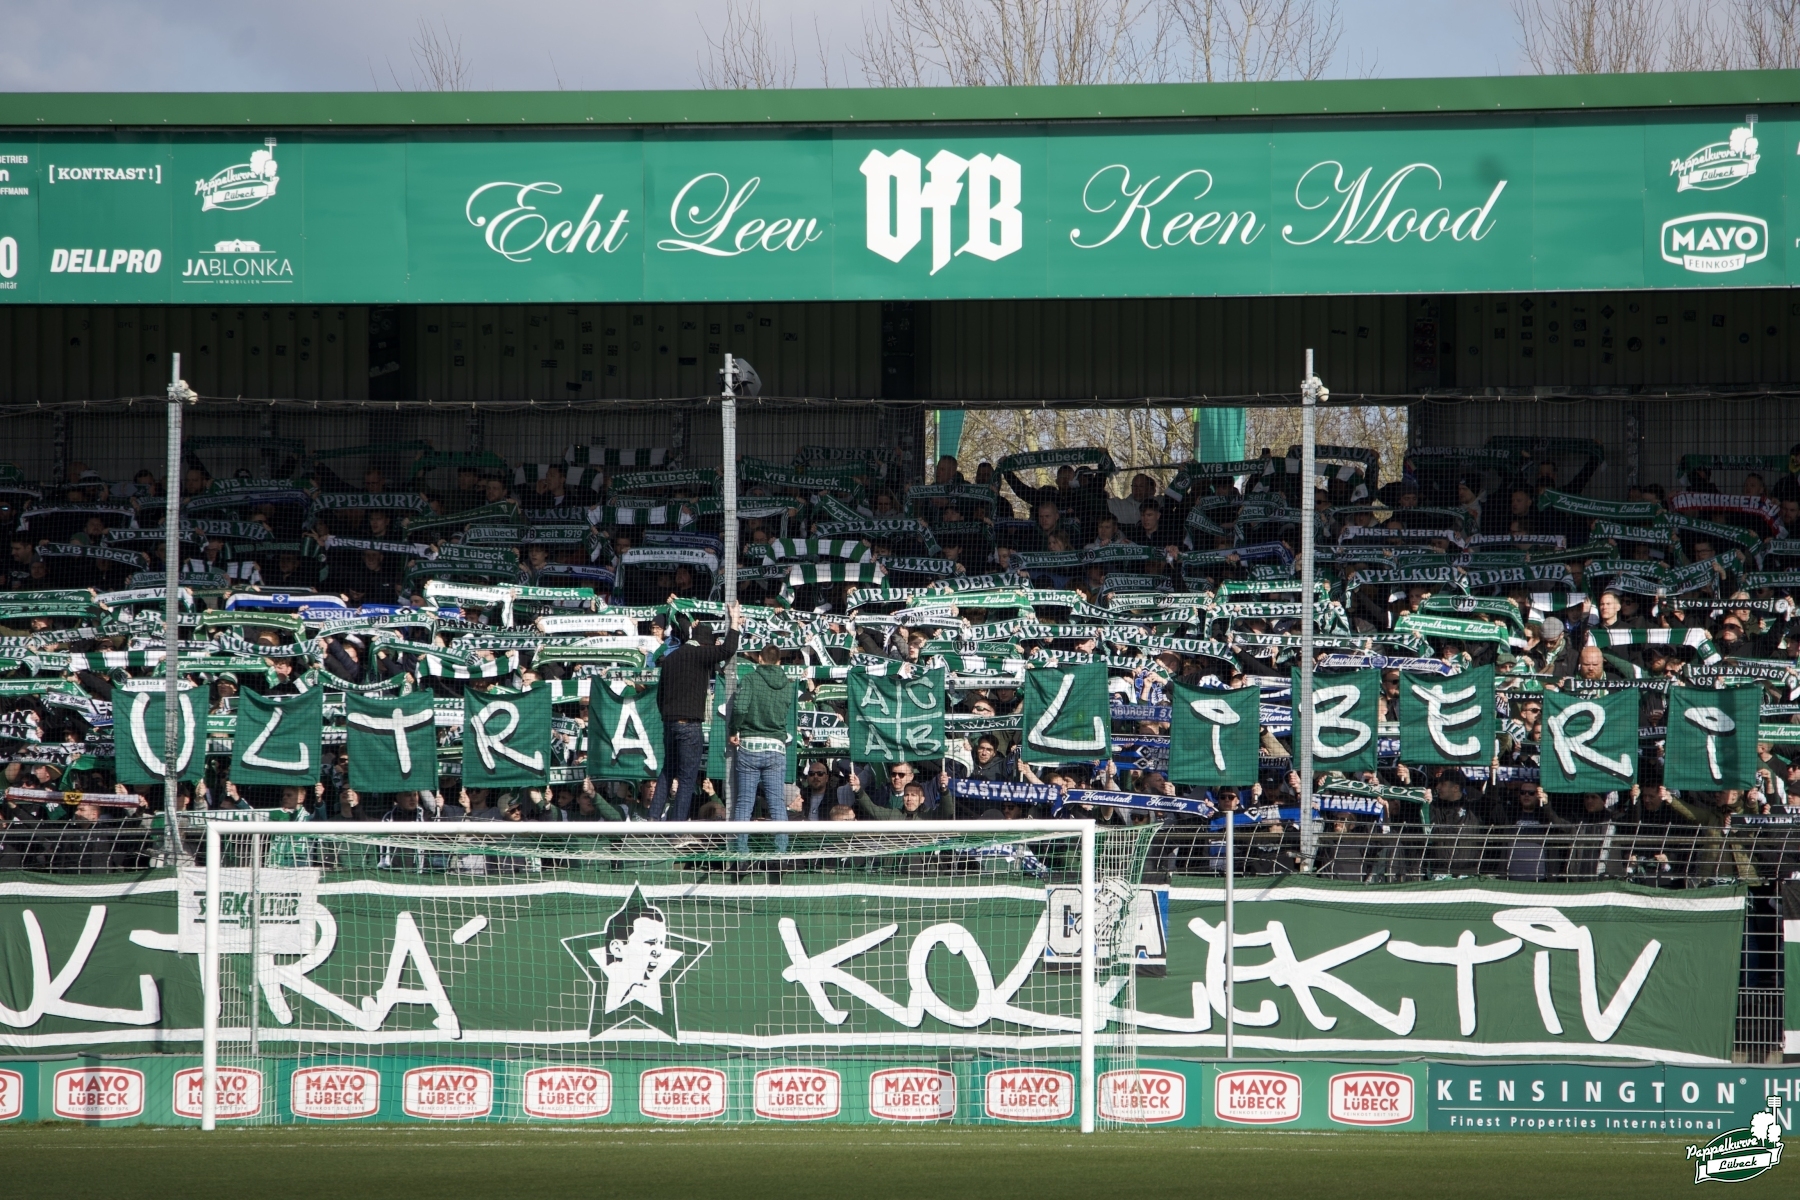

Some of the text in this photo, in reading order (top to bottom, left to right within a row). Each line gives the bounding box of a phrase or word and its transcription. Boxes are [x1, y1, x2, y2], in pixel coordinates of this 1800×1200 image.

[1669, 148, 1737, 177] Pappelkurve
[195, 167, 258, 196] Pappelkurve
[1700, 167, 1735, 181] Lübeck
[223, 188, 256, 201] Lübeck
[1070, 160, 1508, 249] Keen Mood
[465, 172, 823, 263] Echt Leev
[858, 149, 1023, 276] VfB
[1672, 226, 1758, 251] MAYO
[50, 249, 162, 274] DELLPRO
[182, 258, 294, 277] JABLONKA
[1688, 257, 1742, 269] FEINKOST
[1600, 524, 1669, 539] VfB Lübeck
[1664, 513, 1740, 539] VfB Lübeck
[540, 530, 559, 538] seit
[563, 530, 583, 538] 1919
[1606, 561, 1657, 573] Lübeck
[1178, 596, 1197, 604] seit
[393, 614, 411, 622] seit
[1401, 616, 1499, 634] Pappelkurve Lübeck
[1257, 636, 1281, 644] VfB
[229, 657, 262, 665] Lübeck
[1693, 666, 1784, 679] KÜSTENJUNGS
[1576, 679, 1665, 690] KÜSTENJUNGS
[956, 783, 1058, 801] CASTAWAYS
[1081, 792, 1188, 810] Hansestadt Hamburg
[68, 1075, 130, 1092] MAYO
[306, 1075, 365, 1091] MAYO
[418, 1075, 478, 1091] MAYO
[538, 1075, 598, 1091] MAYO
[654, 1075, 712, 1091] MAYO
[768, 1076, 827, 1092] MAYO
[884, 1076, 942, 1092] MAYO
[1000, 1077, 1060, 1093] MAYO
[1113, 1079, 1171, 1095] MAYO
[1229, 1079, 1288, 1096] MAYO
[1344, 1080, 1401, 1098] MAYO
[68, 1092, 129, 1106] LÜBECK
[306, 1092, 364, 1105] LÜBECK
[418, 1092, 477, 1105] LÜBECK
[538, 1092, 596, 1105] LÜBECK
[654, 1092, 711, 1106] LÜBECK
[768, 1093, 825, 1106] LÜBECK
[884, 1093, 940, 1106] LÜBECK
[1000, 1093, 1059, 1108] LÜBECK
[1113, 1096, 1170, 1109] LÜBECK
[1229, 1096, 1286, 1110] LÜBECK
[1344, 1098, 1399, 1112] LÜBECK
[1450, 1115, 1722, 1130] Finest Properties International
